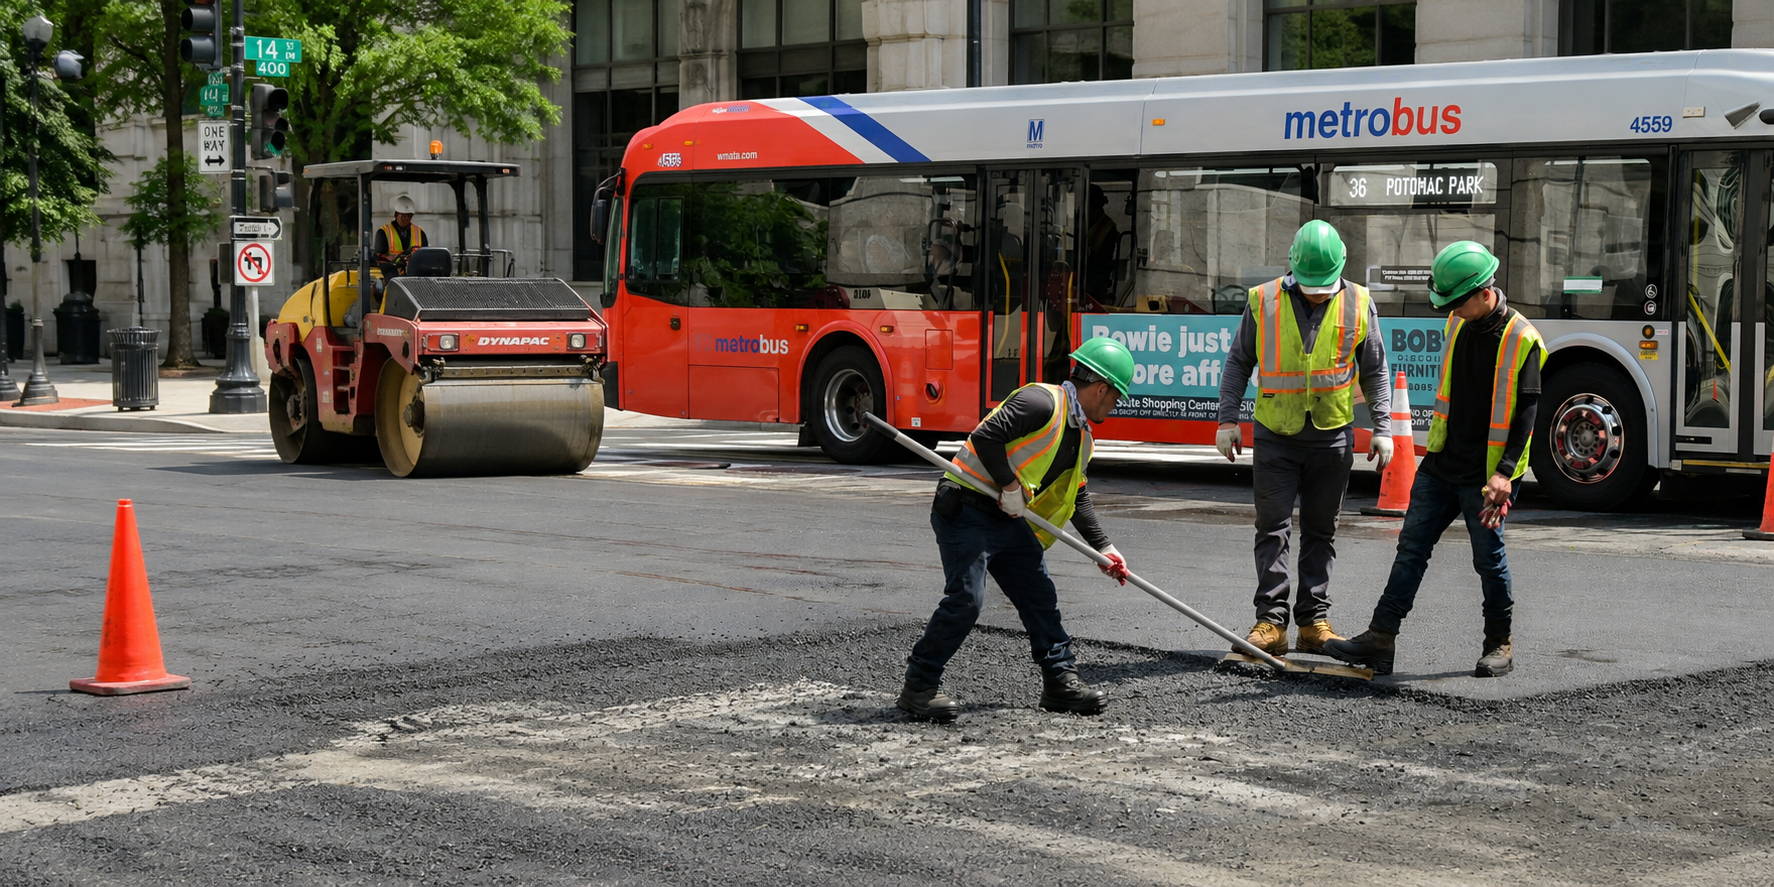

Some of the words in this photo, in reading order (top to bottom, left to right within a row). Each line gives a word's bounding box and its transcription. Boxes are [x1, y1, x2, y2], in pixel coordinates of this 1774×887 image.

[256, 39, 278, 59] 14
[258, 62, 286, 75] 400
[1284, 97, 1462, 139] metrobus
[1630, 115, 1673, 133] 4559
[204, 126, 225, 137] ONE
[1029, 120, 1043, 141] M
[717, 151, 757, 160] wmata.com
[1349, 177, 1367, 198] 36
[1448, 175, 1484, 195] PARK
[477, 336, 550, 346] DYNAPAC
[715, 334, 789, 354] metrobus
[1178, 326, 1231, 358] just
[1391, 329, 1446, 353] BOB'
[1134, 363, 1174, 385] ore
[1181, 359, 1222, 386] aff
[1391, 363, 1441, 378] FURNIT
[1142, 397, 1186, 412] Shopping
